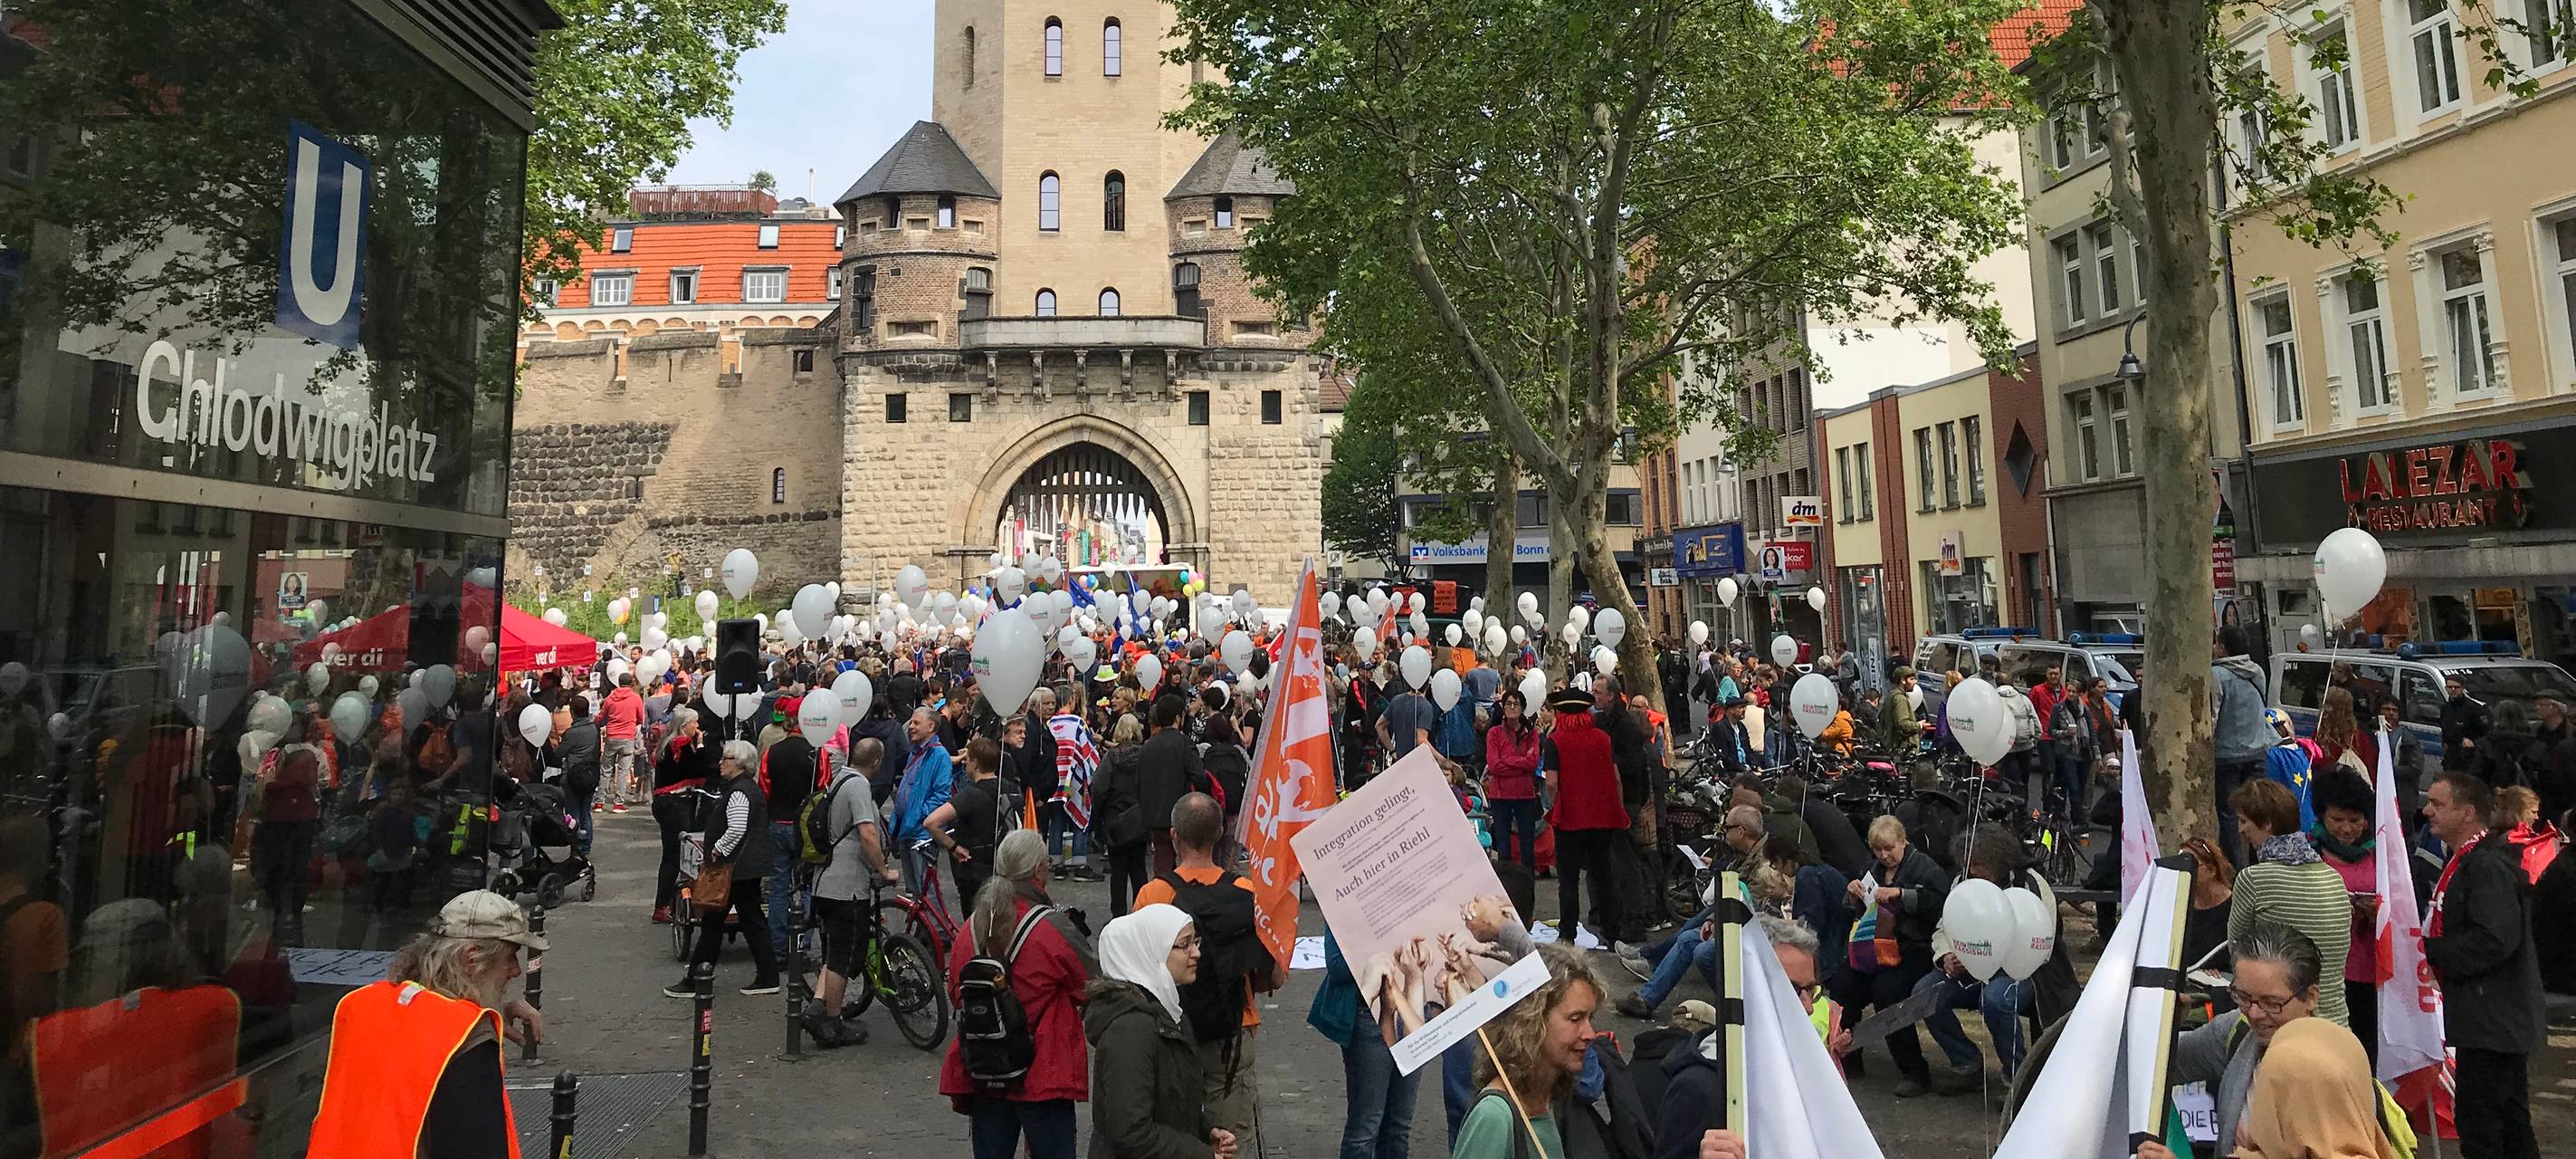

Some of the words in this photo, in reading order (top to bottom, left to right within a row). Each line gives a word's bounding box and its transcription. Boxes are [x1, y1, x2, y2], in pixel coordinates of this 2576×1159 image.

[290, 136, 363, 326] U
[137, 340, 437, 491] Chlodwigplatz
[2339, 439, 2524, 503] LALEZAR
[1791, 500, 1817, 516] dm
[2366, 498, 2498, 532] RESTAURANT
[1432, 545, 1485, 557] Volksbank
[1516, 544, 1544, 555] Bonn
[360, 647, 384, 666] di
[535, 651, 548, 666] ver
[548, 646, 558, 664] di
[1313, 813, 1374, 860] Integration
[1374, 785, 1416, 821] gelingt,
[1334, 873, 1363, 902] Auch
[1362, 858, 1388, 881] hier
[1388, 850, 1400, 865] in
[1398, 826, 1432, 854] Riehl
